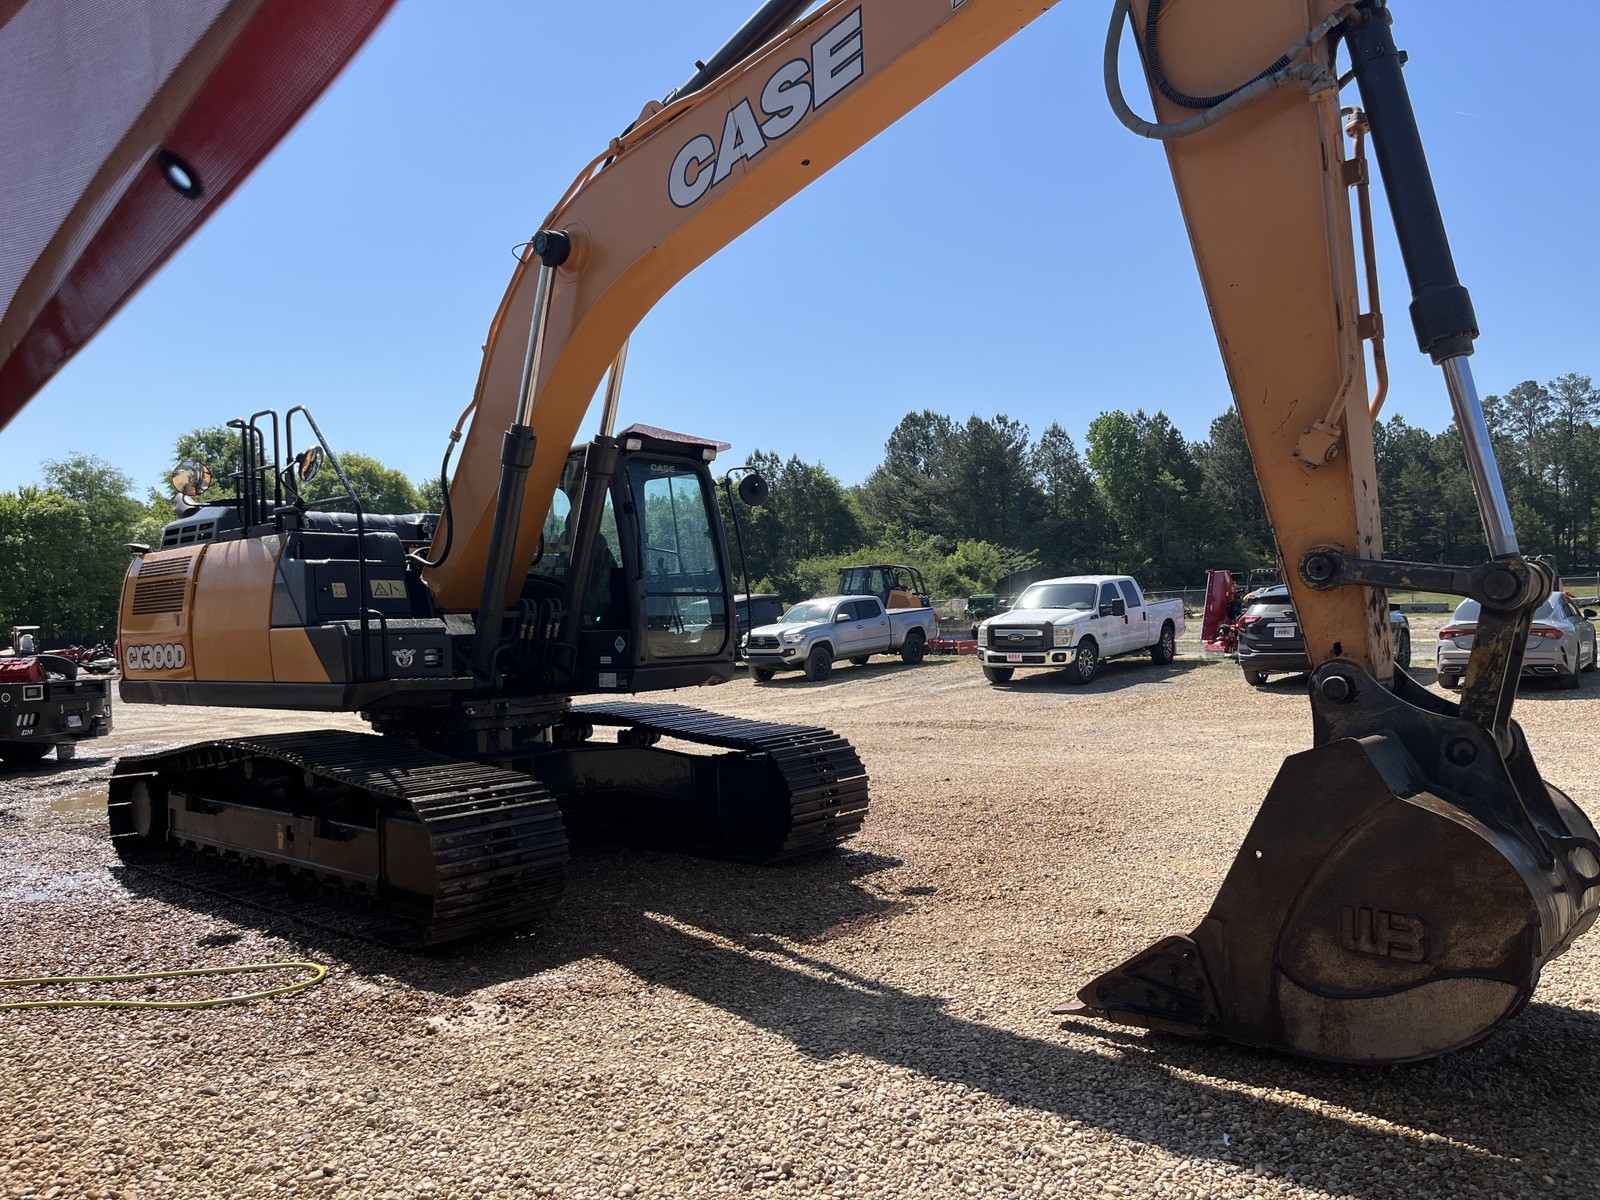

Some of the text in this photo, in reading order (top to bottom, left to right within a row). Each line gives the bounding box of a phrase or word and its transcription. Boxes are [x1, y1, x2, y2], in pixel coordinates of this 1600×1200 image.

[668, 5, 864, 208] CASE
[650, 463, 676, 473] CASE
[126, 642, 187, 670] CX300D
